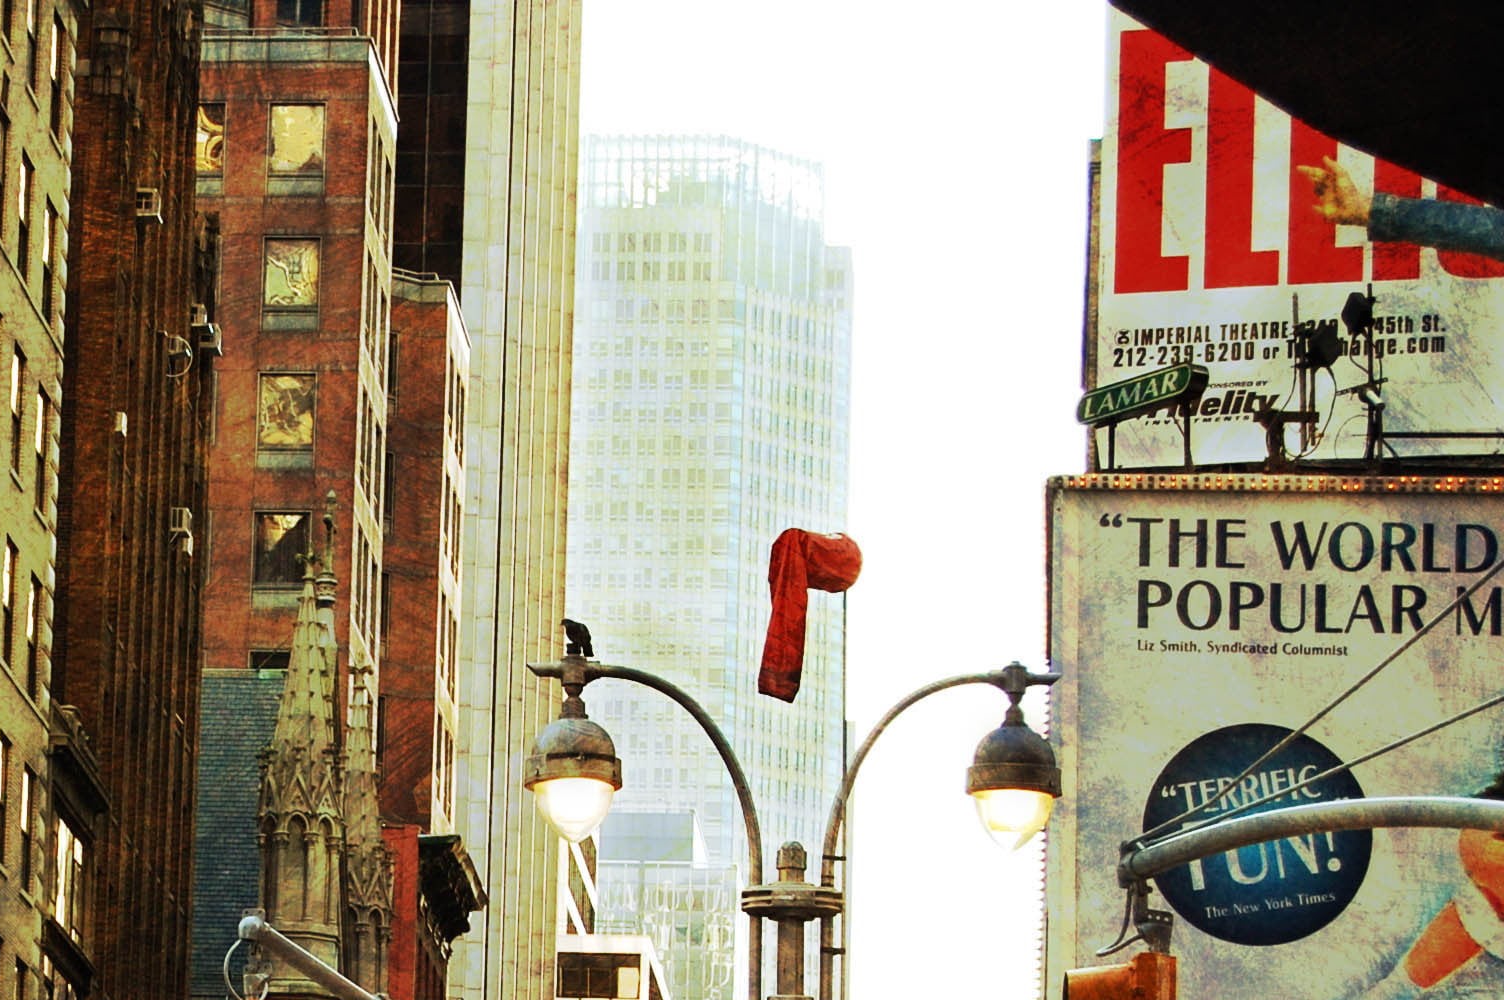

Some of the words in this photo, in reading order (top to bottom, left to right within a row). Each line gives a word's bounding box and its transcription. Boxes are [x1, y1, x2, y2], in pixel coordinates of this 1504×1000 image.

[1134, 325, 1212, 346] IMPERIAL
[1422, 314, 1446, 332] St.
[1113, 342, 1256, 368] 212-239-6200
[1262, 347, 1280, 361] or
[1081, 369, 1181, 421] LAMAR
[1208, 381, 1254, 389] ONSORED
[1270, 519, 1497, 575] WORLD
[1136, 579, 1426, 635] POPULAR
[1137, 640, 1155, 652] Liz
[1160, 640, 1201, 653] Smith,
[1207, 641, 1278, 656] Syndicated
[1282, 643, 1349, 657] Columnist
[1205, 906, 1229, 919] The
[1234, 903, 1260, 915] New
[1265, 897, 1293, 911] York
[1297, 892, 1336, 906] Times
